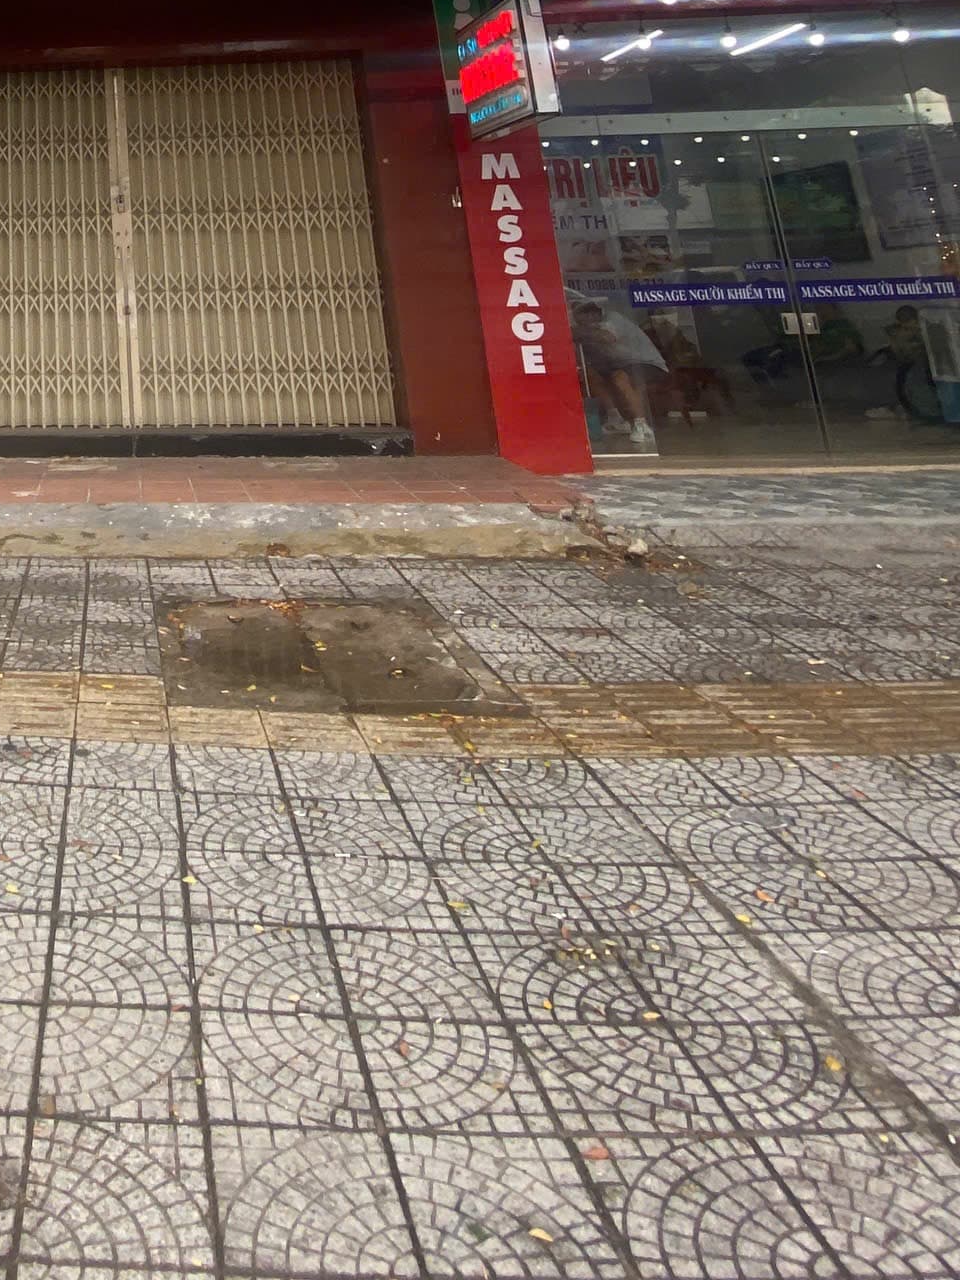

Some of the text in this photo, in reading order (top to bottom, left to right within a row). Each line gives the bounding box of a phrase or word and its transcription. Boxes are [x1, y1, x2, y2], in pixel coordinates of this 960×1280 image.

[592, 146, 660, 208] LIỆU
[481, 153, 546, 374] MASSAGE
[634, 284, 786, 303] MASSAGE NGƯỜI KHIẾM THỊ
[801, 278, 956, 298] MASSAGE NGƯỜI KHIẾM THỊ
